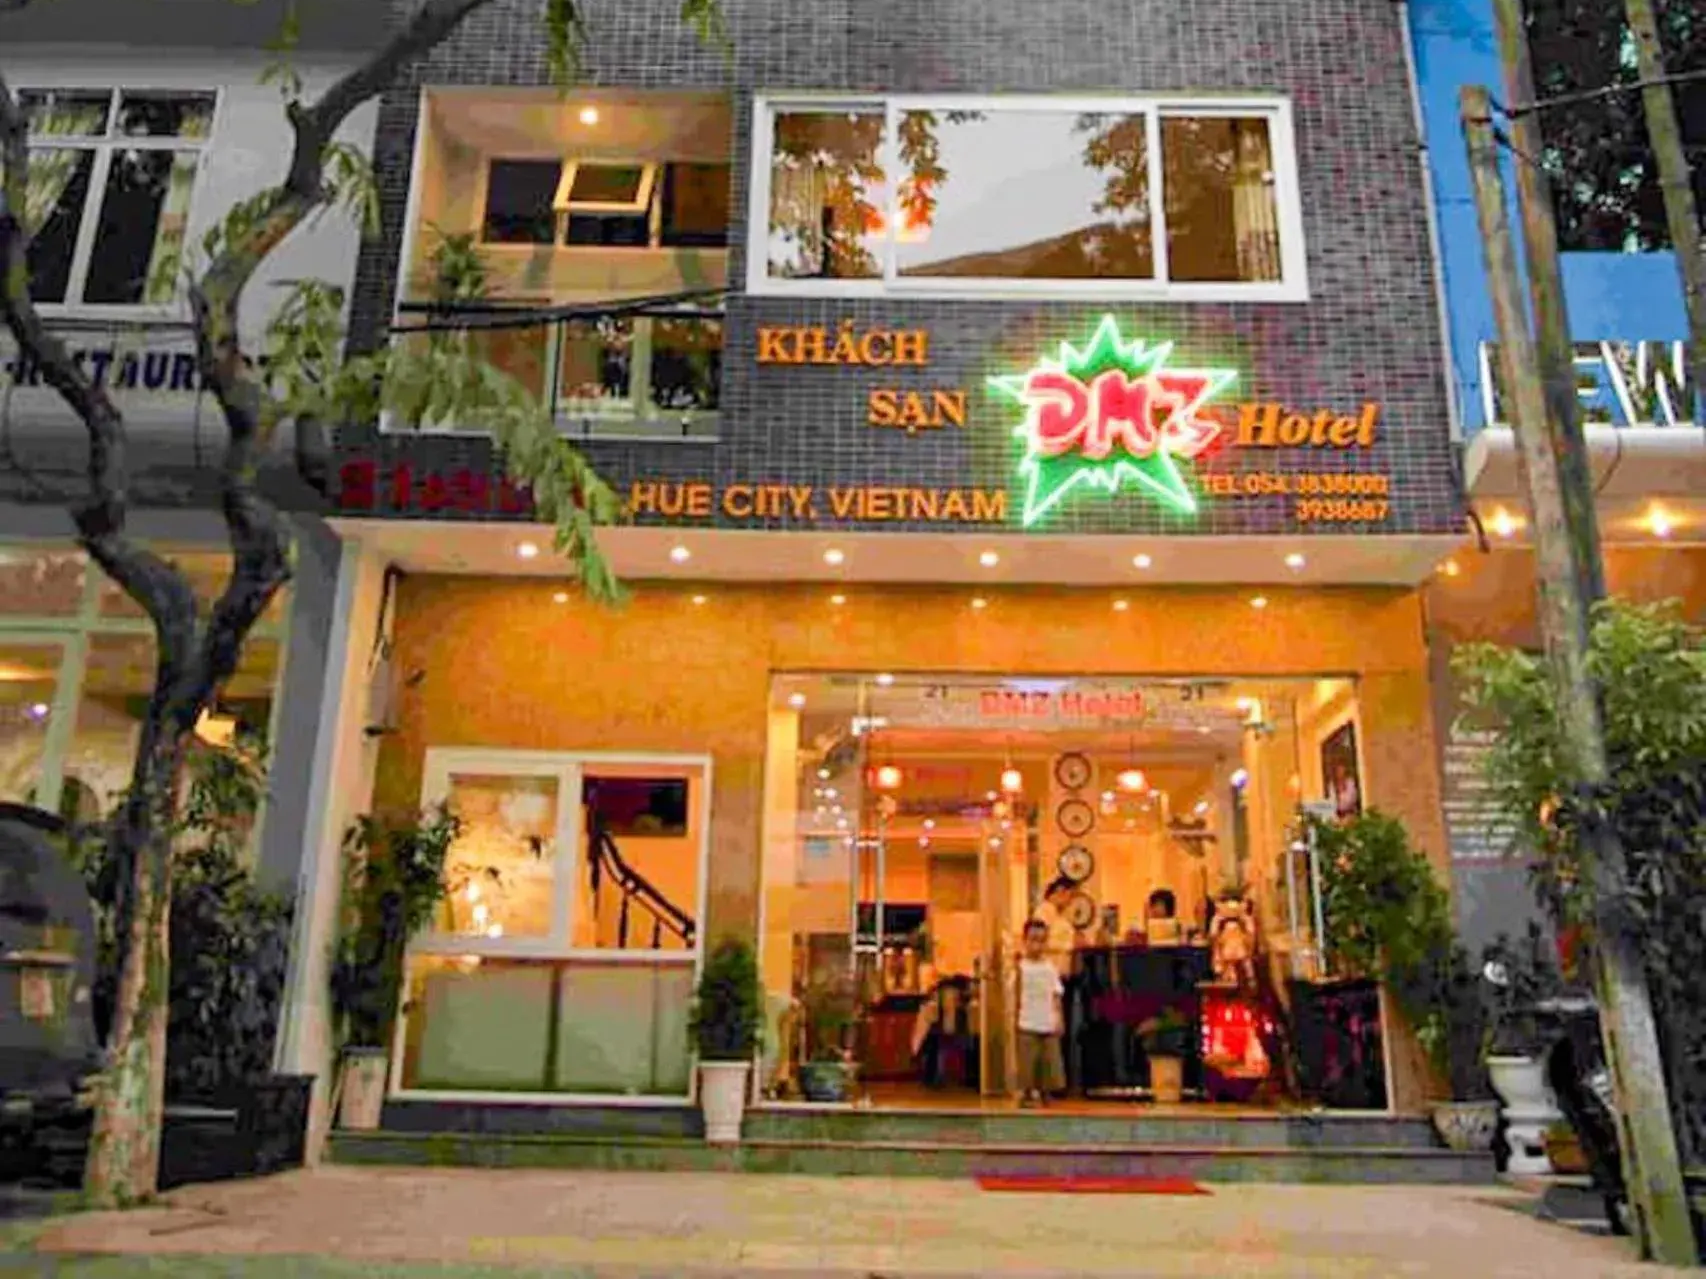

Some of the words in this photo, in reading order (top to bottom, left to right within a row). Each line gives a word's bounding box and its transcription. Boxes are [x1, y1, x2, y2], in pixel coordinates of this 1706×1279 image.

[757, 319, 927, 365] KHÁCH
[867, 390, 967, 436] SẠN
[1026, 368, 1224, 460] DMZ
[1235, 402, 1380, 448] Hotel
[632, 482, 712, 517] HUE
[828, 486, 1006, 520] VIETNAM
